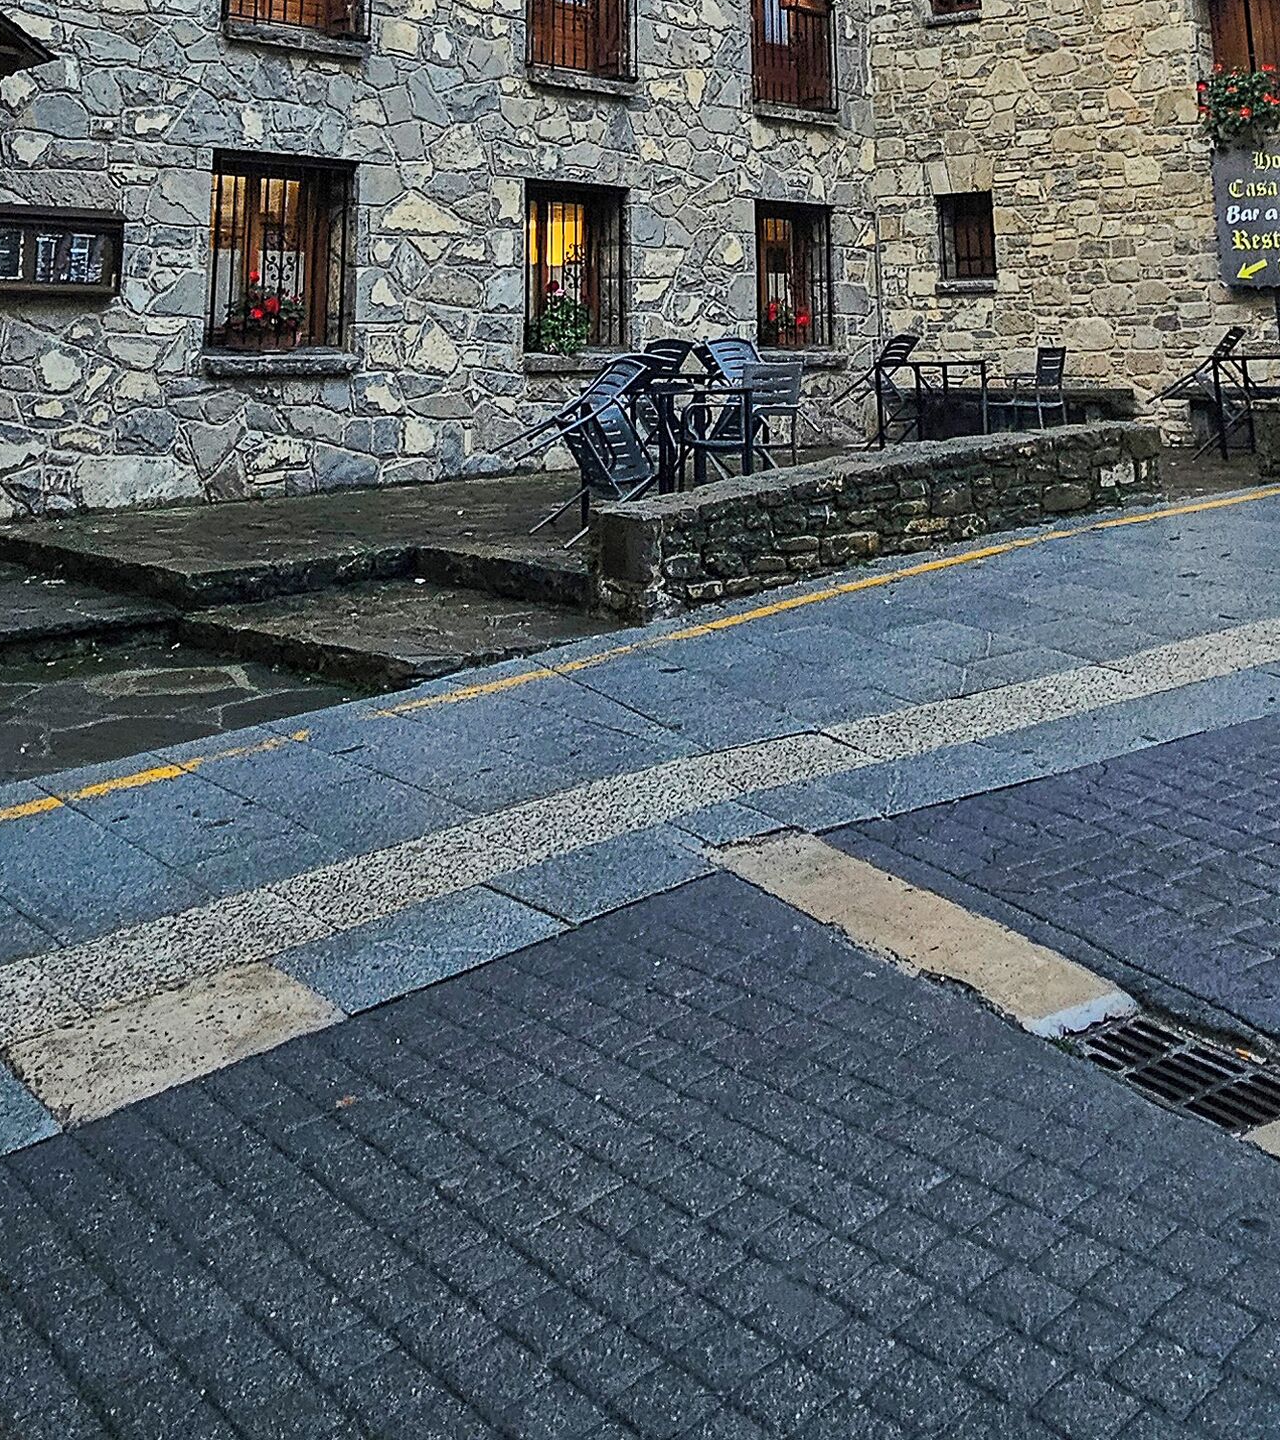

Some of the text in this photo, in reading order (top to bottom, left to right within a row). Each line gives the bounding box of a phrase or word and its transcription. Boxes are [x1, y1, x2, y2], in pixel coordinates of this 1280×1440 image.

[1229, 178, 1278, 199] Casa
[1226, 205, 1261, 225] Bar
[1265, 207, 1279, 220] a
